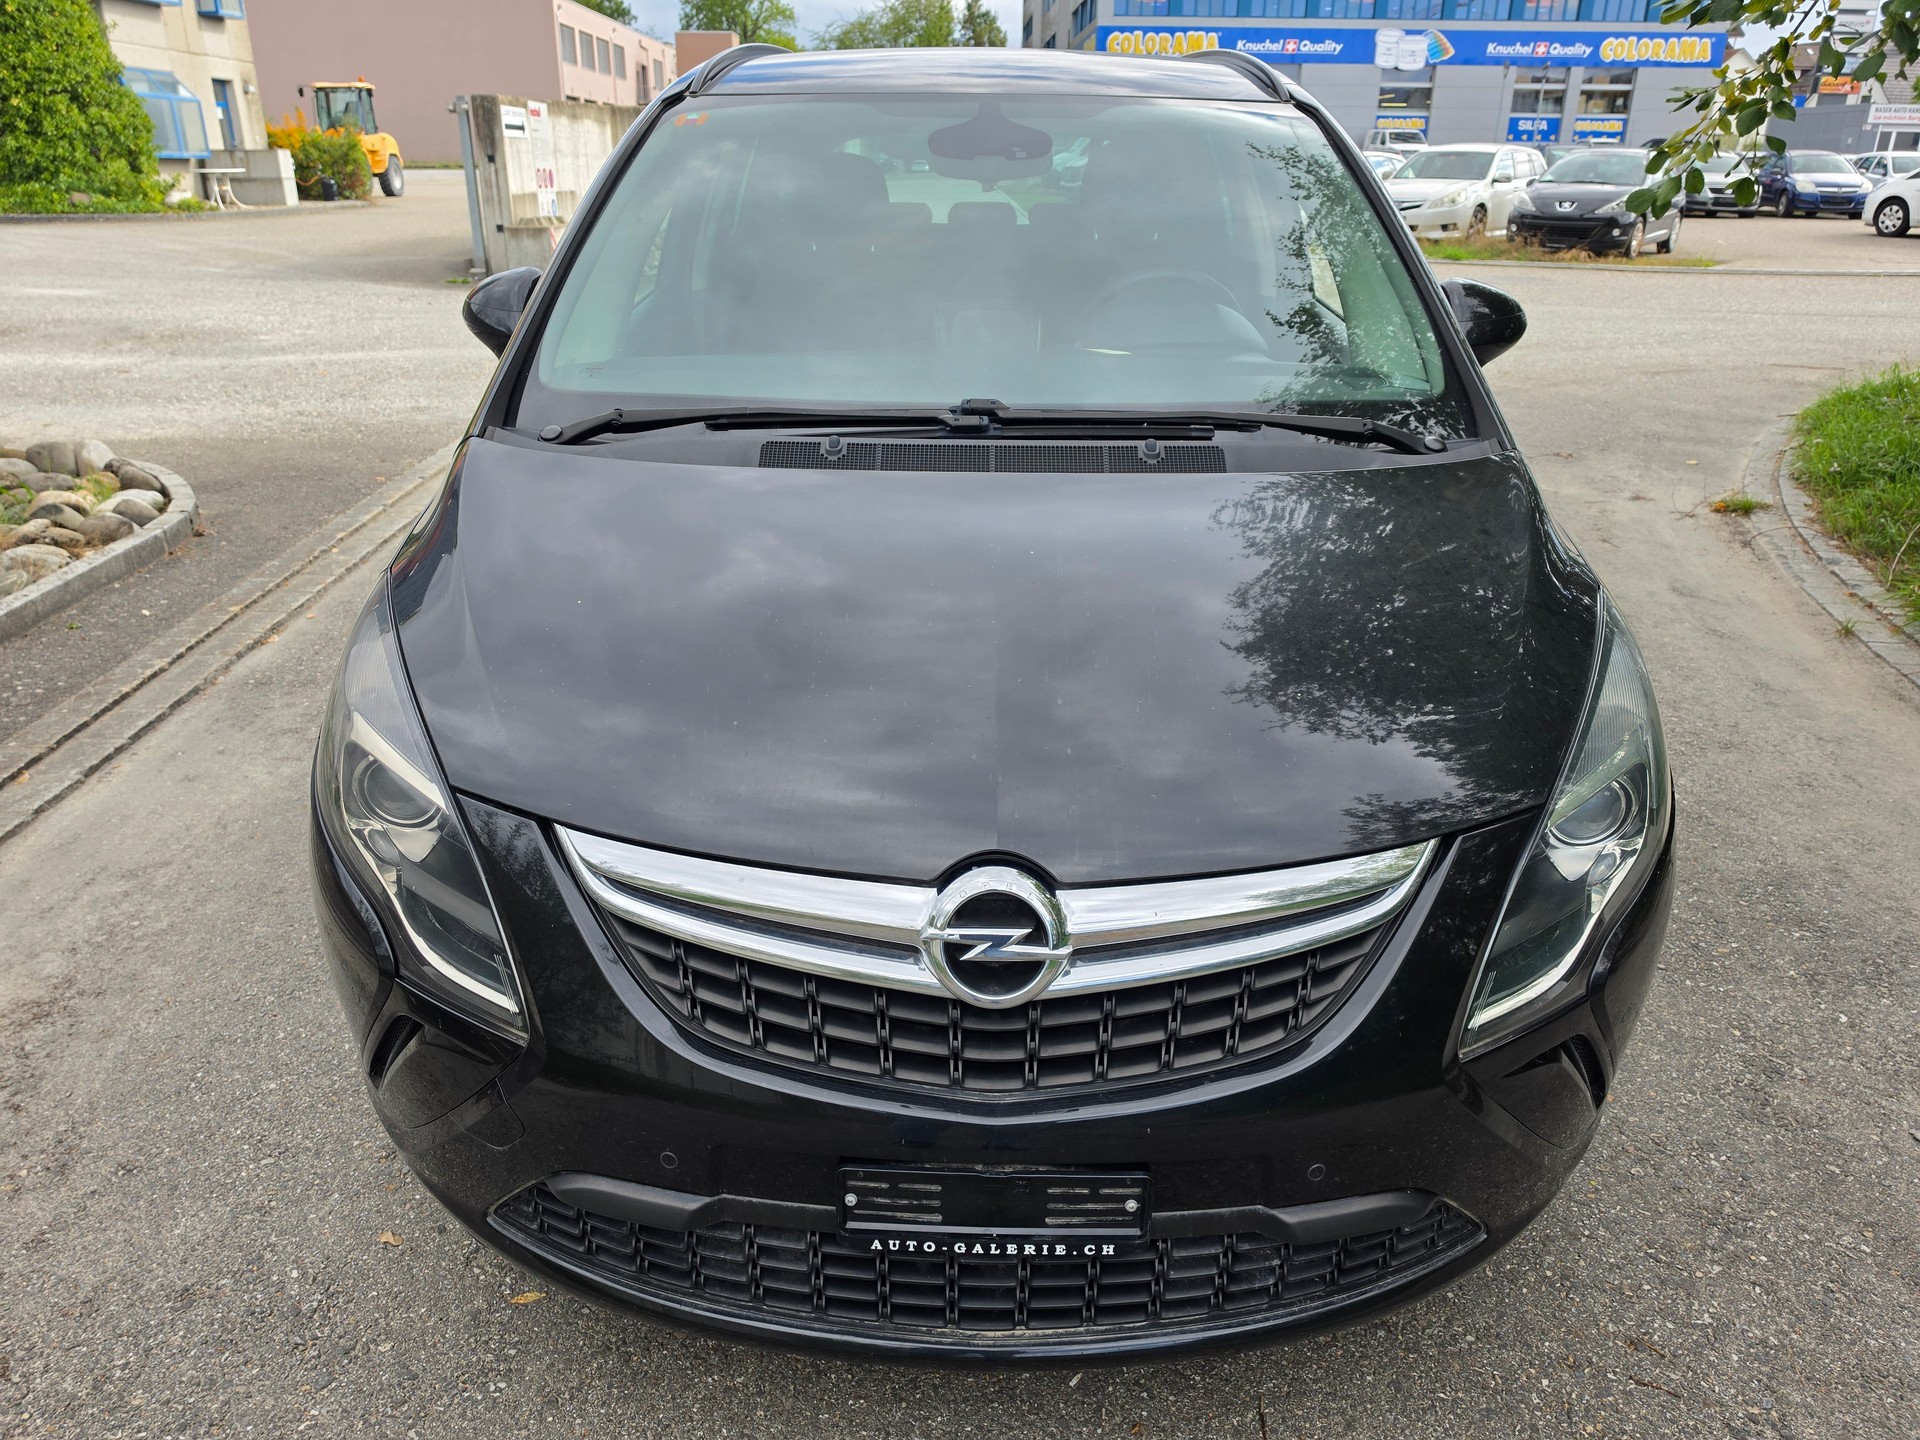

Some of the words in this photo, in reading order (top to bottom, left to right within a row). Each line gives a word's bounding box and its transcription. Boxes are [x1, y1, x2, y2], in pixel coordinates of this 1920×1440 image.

[1106, 30, 1219, 56] COLORAMA
[1237, 39, 1284, 51] Knuchel
[1300, 40, 1344, 55] Quality
[1486, 42, 1534, 54] Knuchel
[1549, 43, 1593, 58] Quality
[1599, 36, 1711, 62] COLORAMA
[1377, 118, 1425, 130] COLORAMA
[1574, 119, 1623, 132] COLORAMA
[958, 881, 1035, 901] OPEL
[870, 1239, 1116, 1256] AUTO-GALERIE.CH
